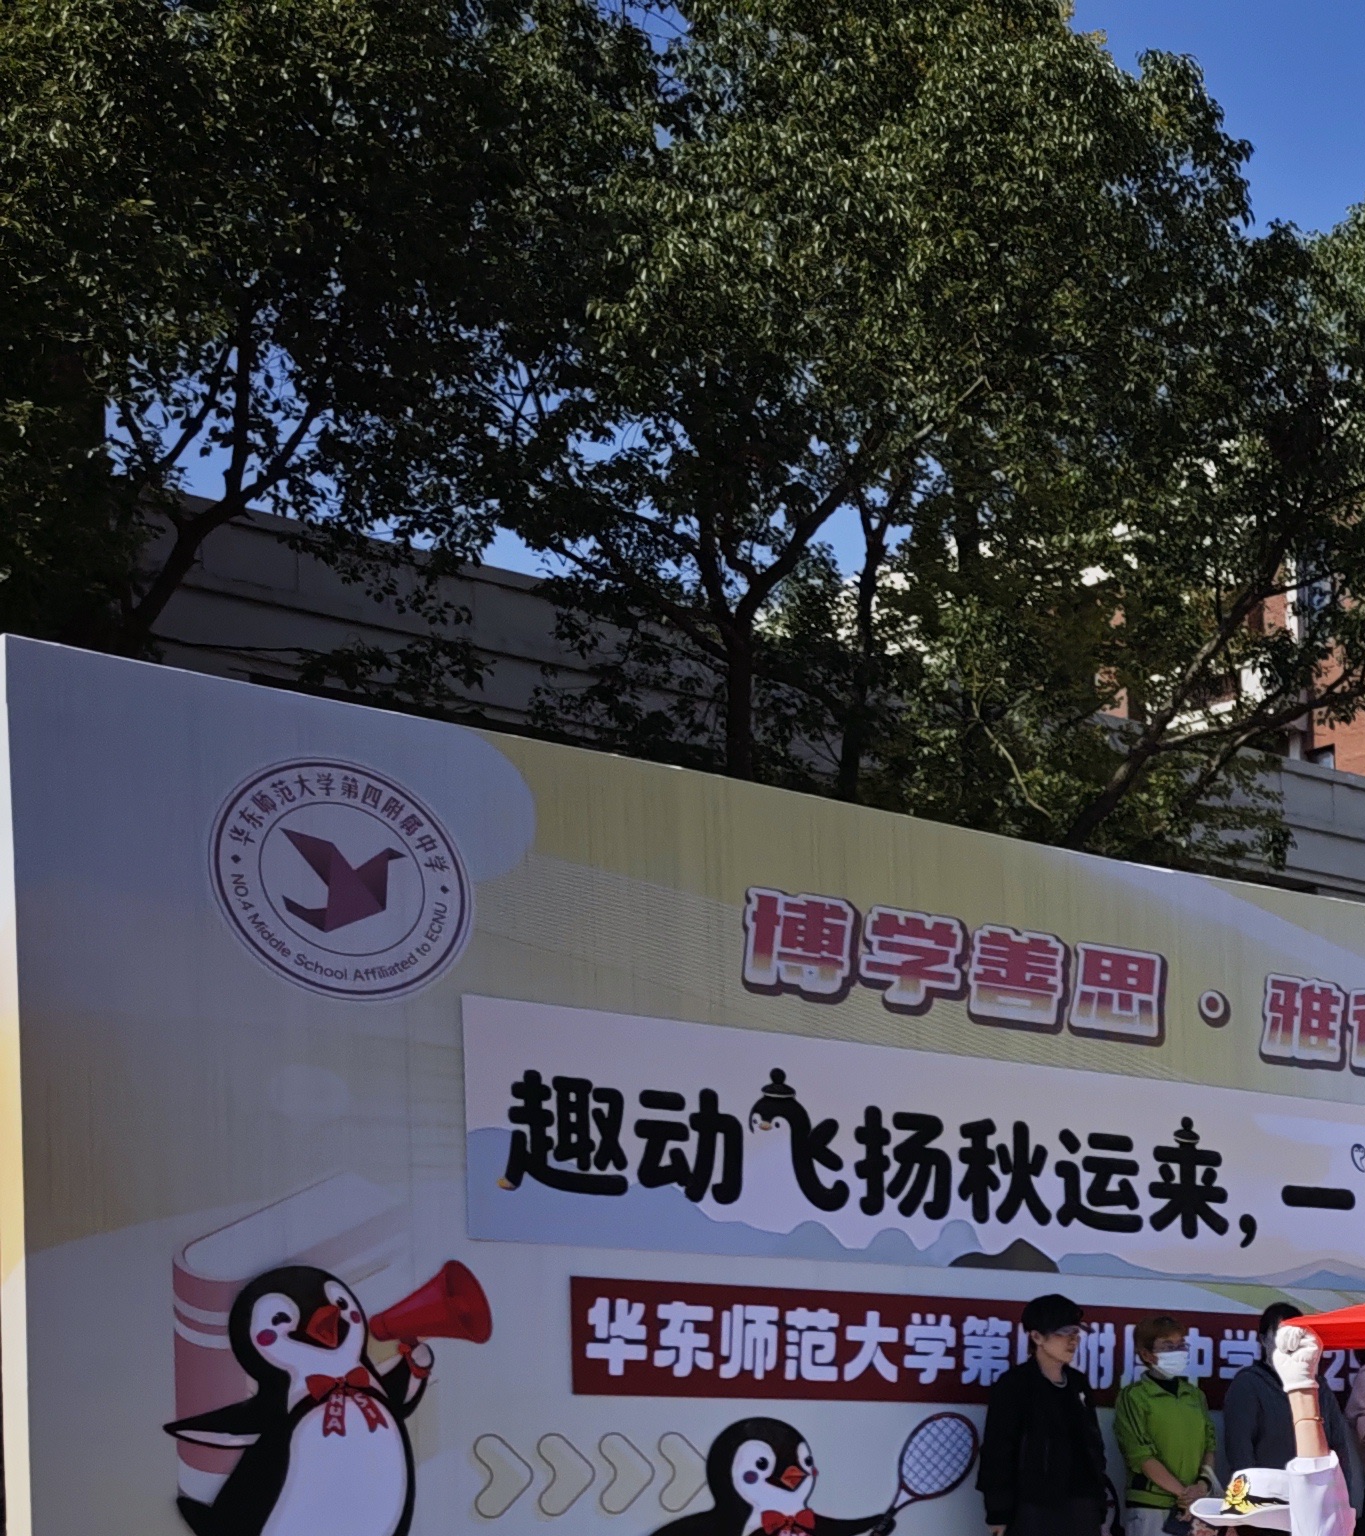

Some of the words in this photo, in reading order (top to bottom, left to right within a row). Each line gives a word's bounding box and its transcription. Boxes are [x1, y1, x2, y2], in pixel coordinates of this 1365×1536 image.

[228, 772, 450, 874] 华东师范大学第四附属中学
[247, 912, 292, 957] Middle
[293, 954, 348, 981] School
[353, 954, 418, 982] Affiliated
[416, 942, 431, 957] to
[424, 902, 449, 943] ECNU
